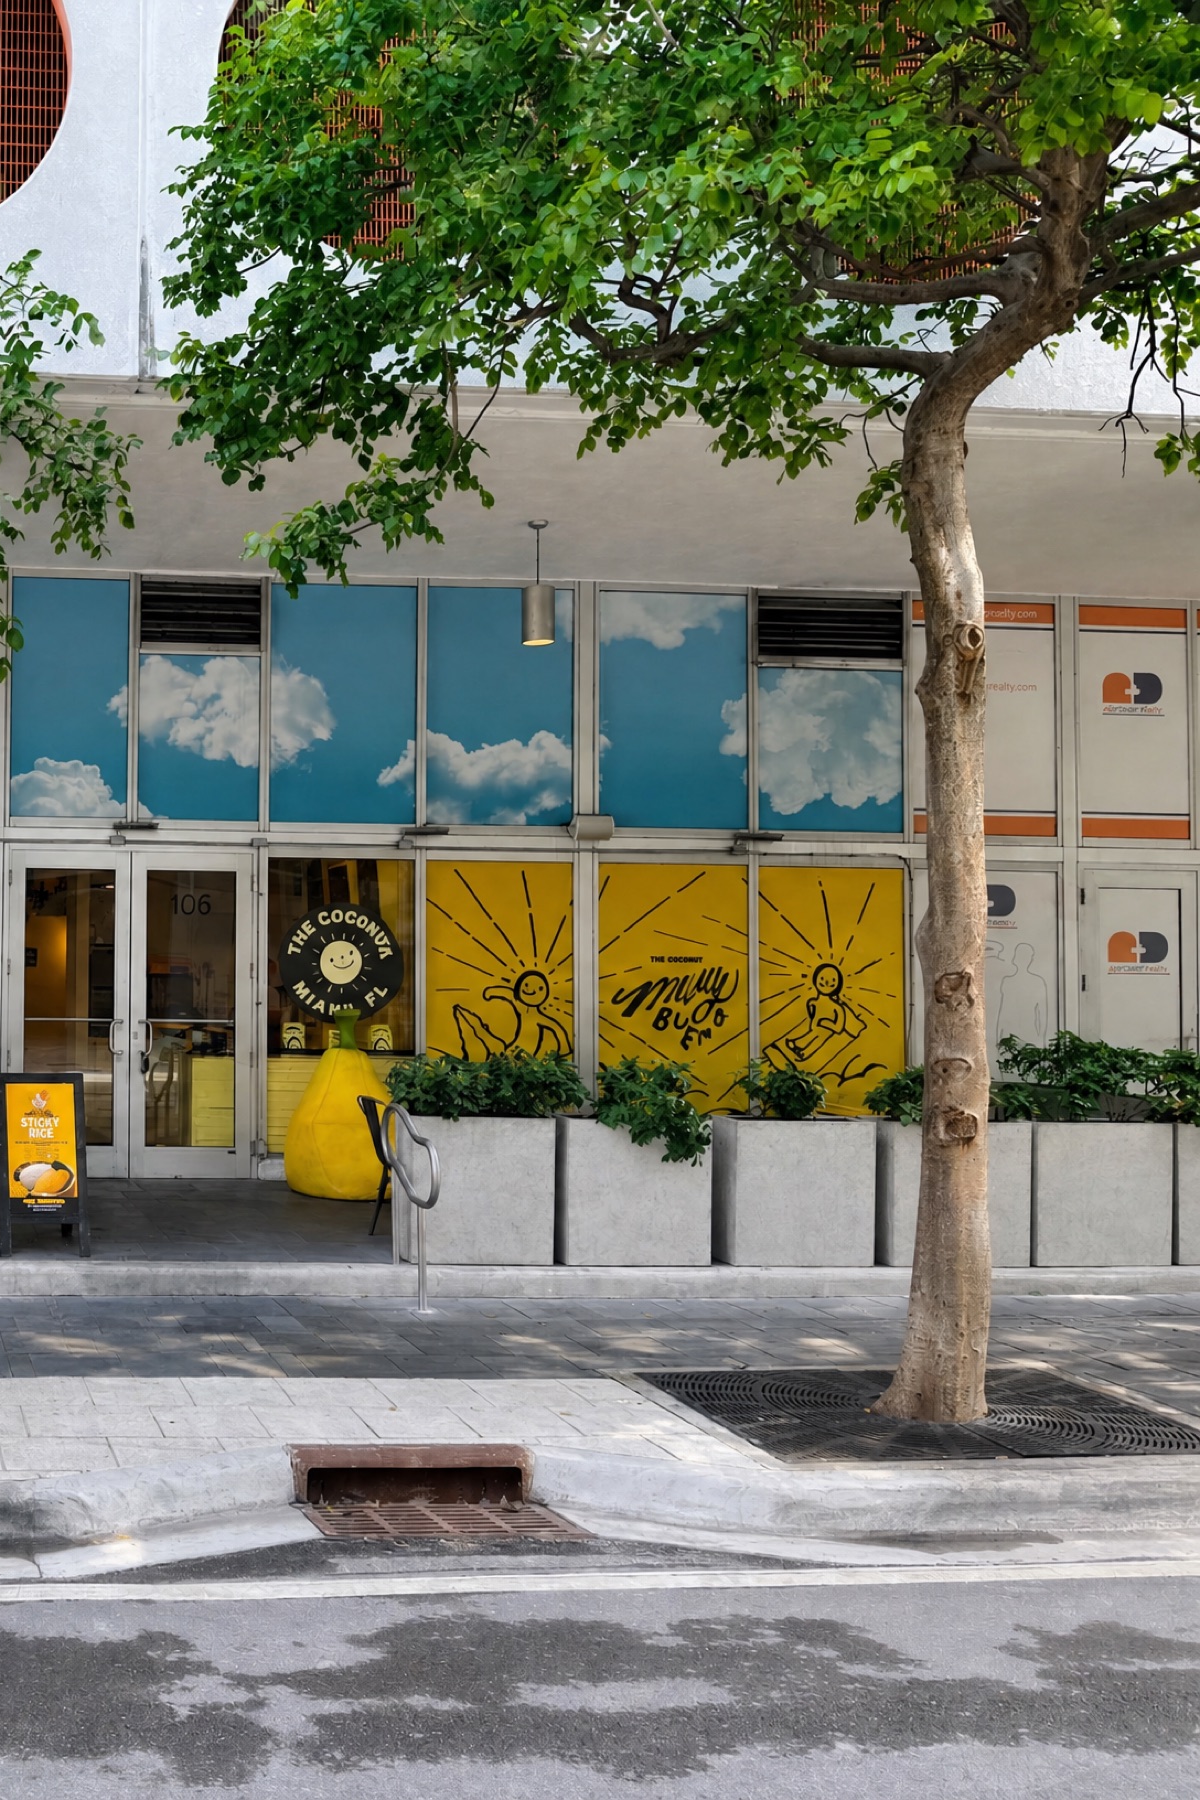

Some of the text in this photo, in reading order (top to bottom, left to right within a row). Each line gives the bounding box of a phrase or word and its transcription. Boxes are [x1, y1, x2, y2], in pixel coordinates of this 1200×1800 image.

[170, 893, 212, 915] 106
[287, 909, 394, 960] THE COCONUT
[650, 955, 704, 964] THE COCONUT
[363, 986, 389, 1008] FL
[20, 1117, 60, 1128] STICKY
[28, 1128, 55, 1138] RICE
